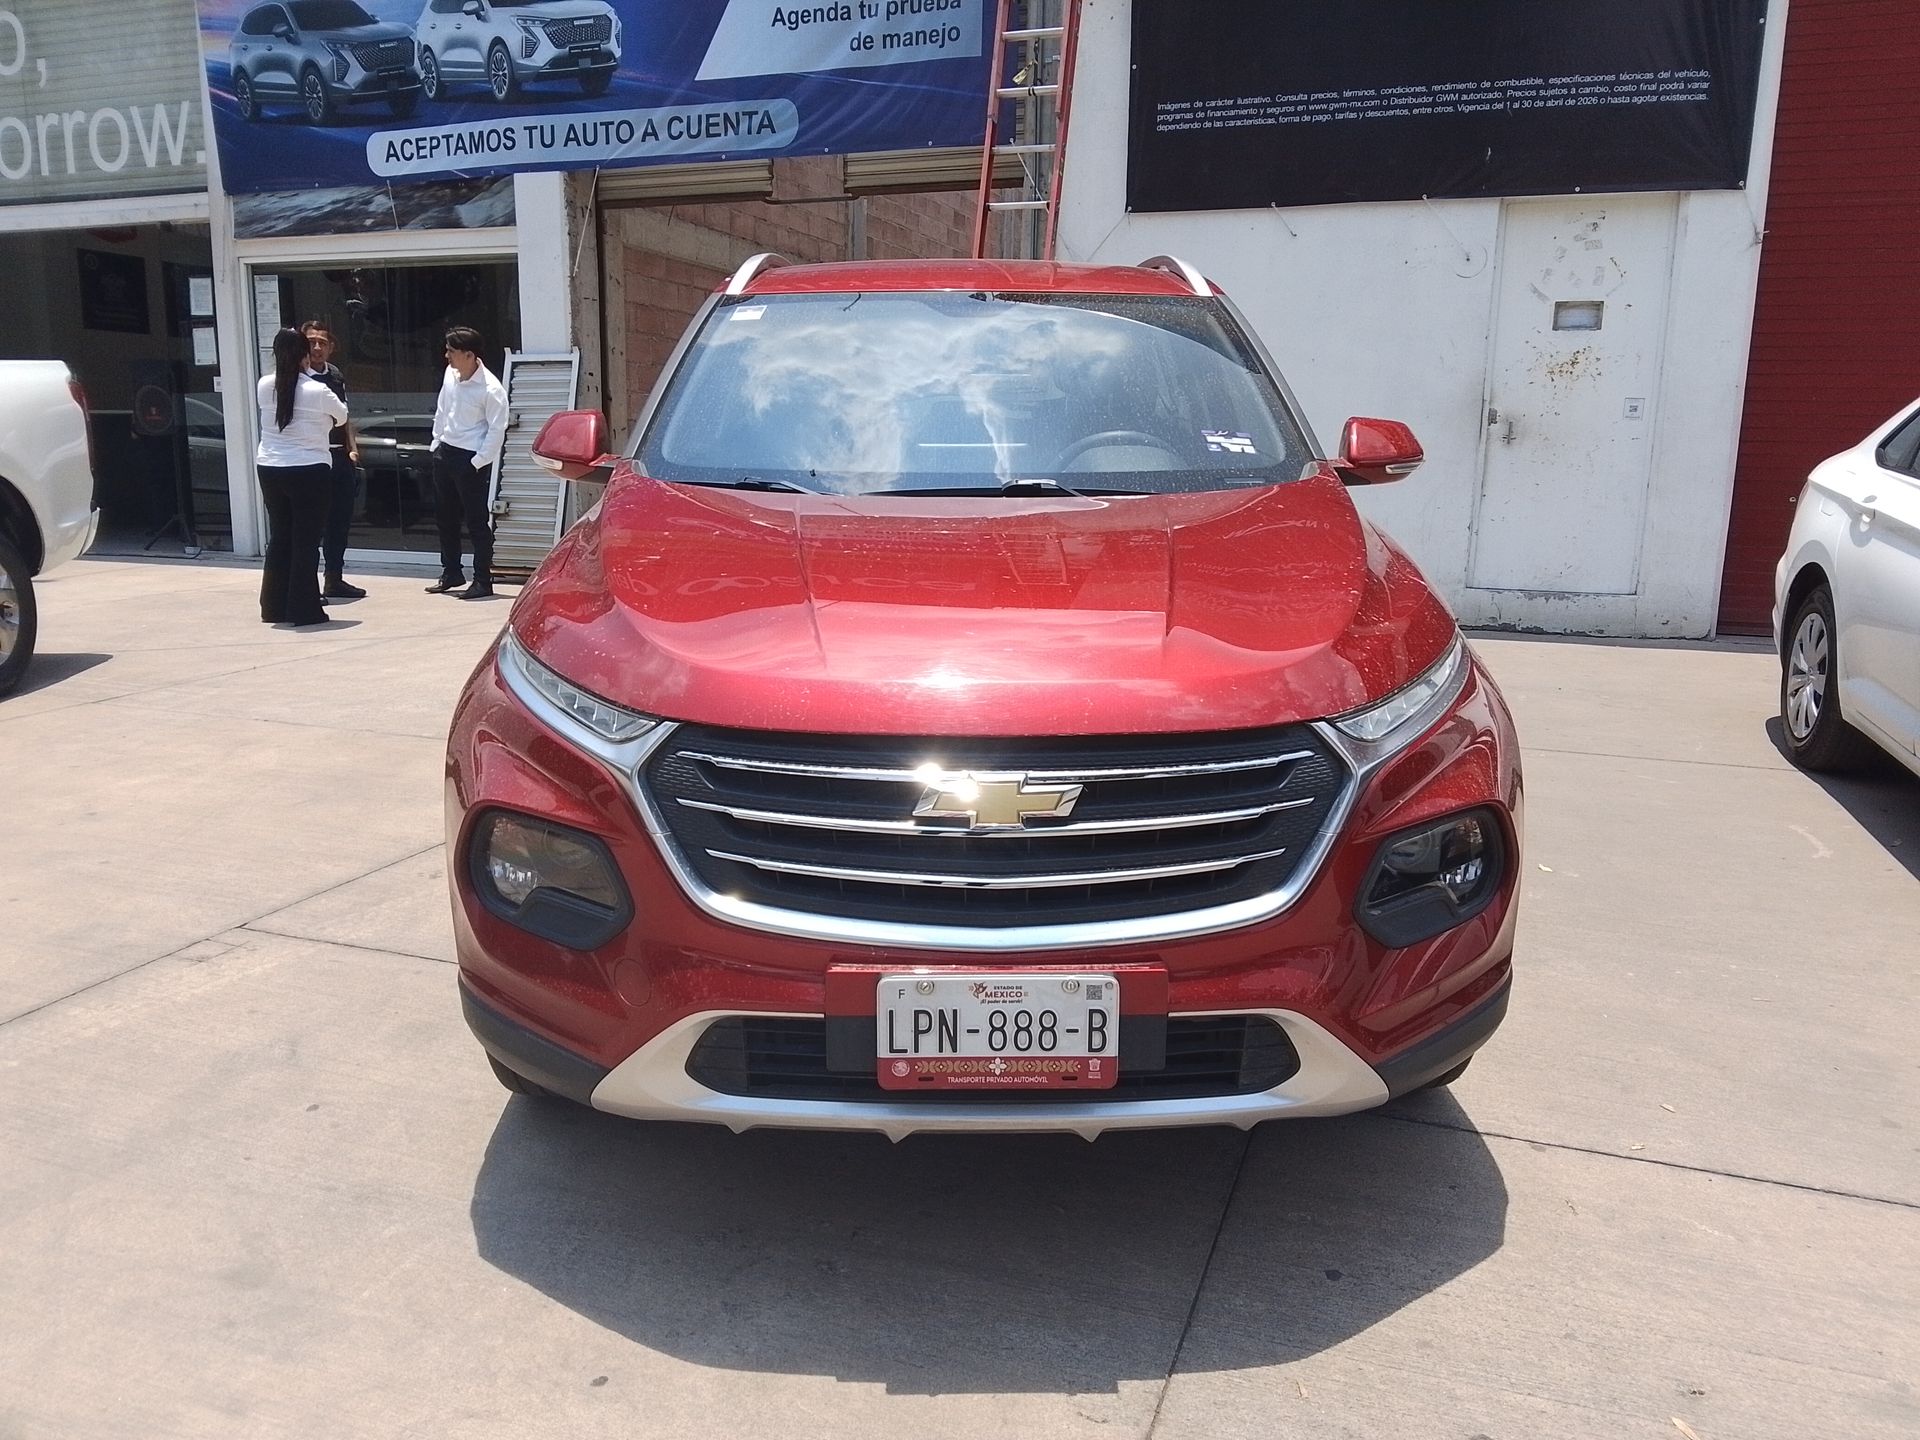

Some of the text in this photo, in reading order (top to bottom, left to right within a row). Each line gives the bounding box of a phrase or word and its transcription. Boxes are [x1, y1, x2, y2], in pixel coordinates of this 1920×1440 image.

[771, 3, 851, 30] Agenda
[858, 2, 880, 20] tu
[850, 23, 961, 51] de manejo
[1157, 101, 1191, 111] Imágenes
[1193, 100, 1203, 108] de
[1275, 93, 1308, 103] Consulta
[1310, 91, 1340, 102] precios,
[1343, 89, 1377, 98] términos,
[1380, 86, 1428, 95] condiciones,
[1431, 81, 1478, 91] rendimiento
[1480, 80, 1491, 88] de
[1494, 77, 1545, 87] combustible,
[1548, 74, 1616, 85] especificaciones
[1619, 71, 1654, 80] técnicas
[1657, 70, 1671, 79] del
[1674, 68, 1711, 78] vehículo,
[1157, 112, 1194, 122] programas
[1206, 108, 1258, 117] financiamiento
[1266, 105, 1295, 115] seguros
[1308, 100, 1381, 111] www.gwm-mx.com
[1390, 96, 1434, 105] Distribuidor
[1435, 92, 1459, 102] GWM
[1460, 91, 1504, 101] autorizado.
[1506, 88, 1537, 98] Precios
[1539, 87, 1568, 98] sujetos
[1578, 85, 1612, 94] cambio,
[1613, 84, 1638, 93] costo
[1640, 82, 1658, 91] final
[1659, 80, 1685, 92] podrá
[1687, 81, 1711, 89] variar
[1156, 121, 1202, 132] dependiendo
[1202, 120, 1213, 128] de
[1213, 120, 1224, 128] las
[1278, 115, 1300, 124] forma
[1300, 114, 1312, 122] de
[1312, 113, 1334, 123] pago,
[1334, 111, 1358, 120] tarifas
[1364, 108, 1411, 118] descuentos,
[1412, 106, 1433, 115] entre
[1457, 101, 1491, 114] Vigencia
[1491, 100, 1505, 110] del
[1512, 100, 1521, 109] al
[1521, 99, 1533, 109] 30
[1533, 98, 1545, 107] de
[1545, 98, 1564, 107] abril
[1564, 97, 1577, 106] de
[1577, 96, 1599, 106] 2026
[1607, 95, 1631, 104] hasta
[1631, 94, 1658, 105] agotar
[1659, 92, 1710, 102] existencias.
[385, 109, 777, 163] ACEPTAMOS TU AUTO A CUENTA
[898, 988, 906, 1000] F
[887, 1007, 1108, 1055] LPN-888-B
[947, 1075, 1049, 1084] TRANSPORTE PRIVADO AUTOMÓVIL
